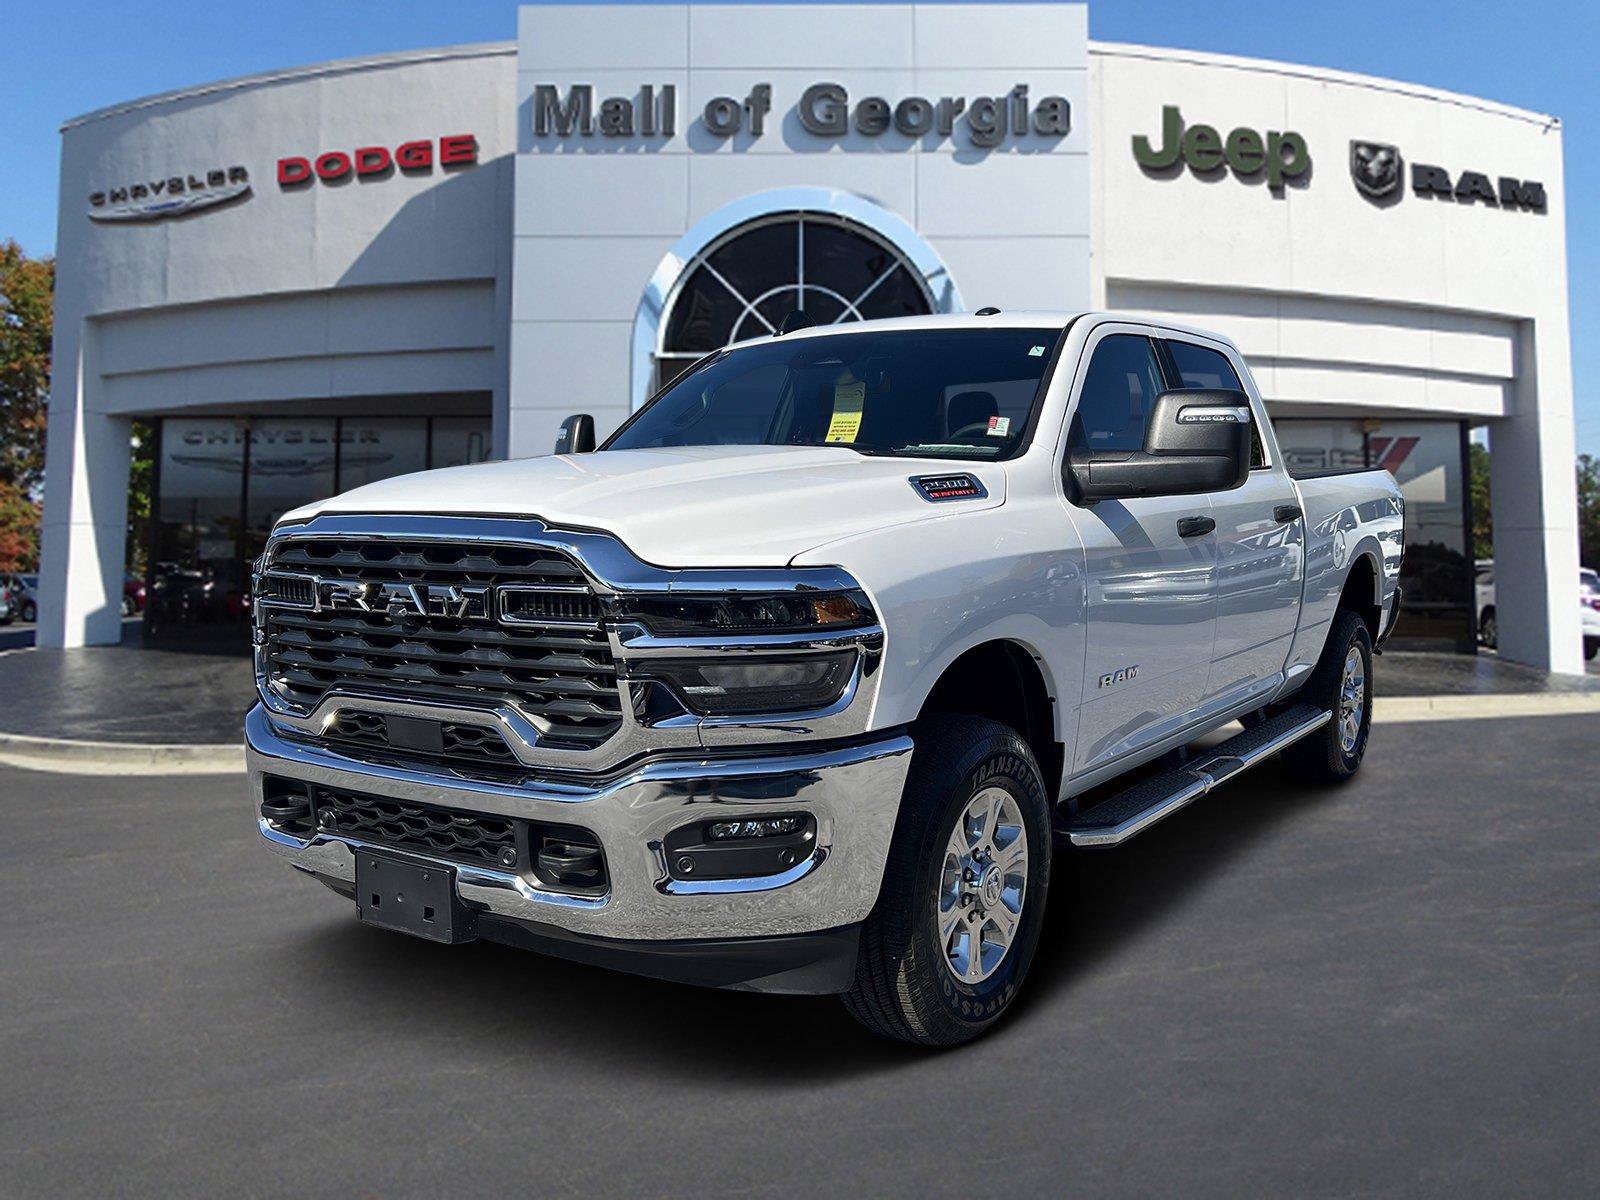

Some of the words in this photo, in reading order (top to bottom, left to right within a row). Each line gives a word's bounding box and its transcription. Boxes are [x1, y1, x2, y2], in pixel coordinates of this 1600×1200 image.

[532, 84, 676, 137] Mall
[704, 83, 772, 137] of
[799, 83, 1072, 148] Georgia
[277, 134, 475, 185] DODGE
[1131, 105, 1309, 187] Jeep
[90, 166, 248, 206] CHRYSLER
[1411, 163, 1545, 208] RAM
[319, 579, 490, 619] RAM
[1098, 664, 1140, 688] RAM
[972, 755, 1042, 806] TRANSFORCE
